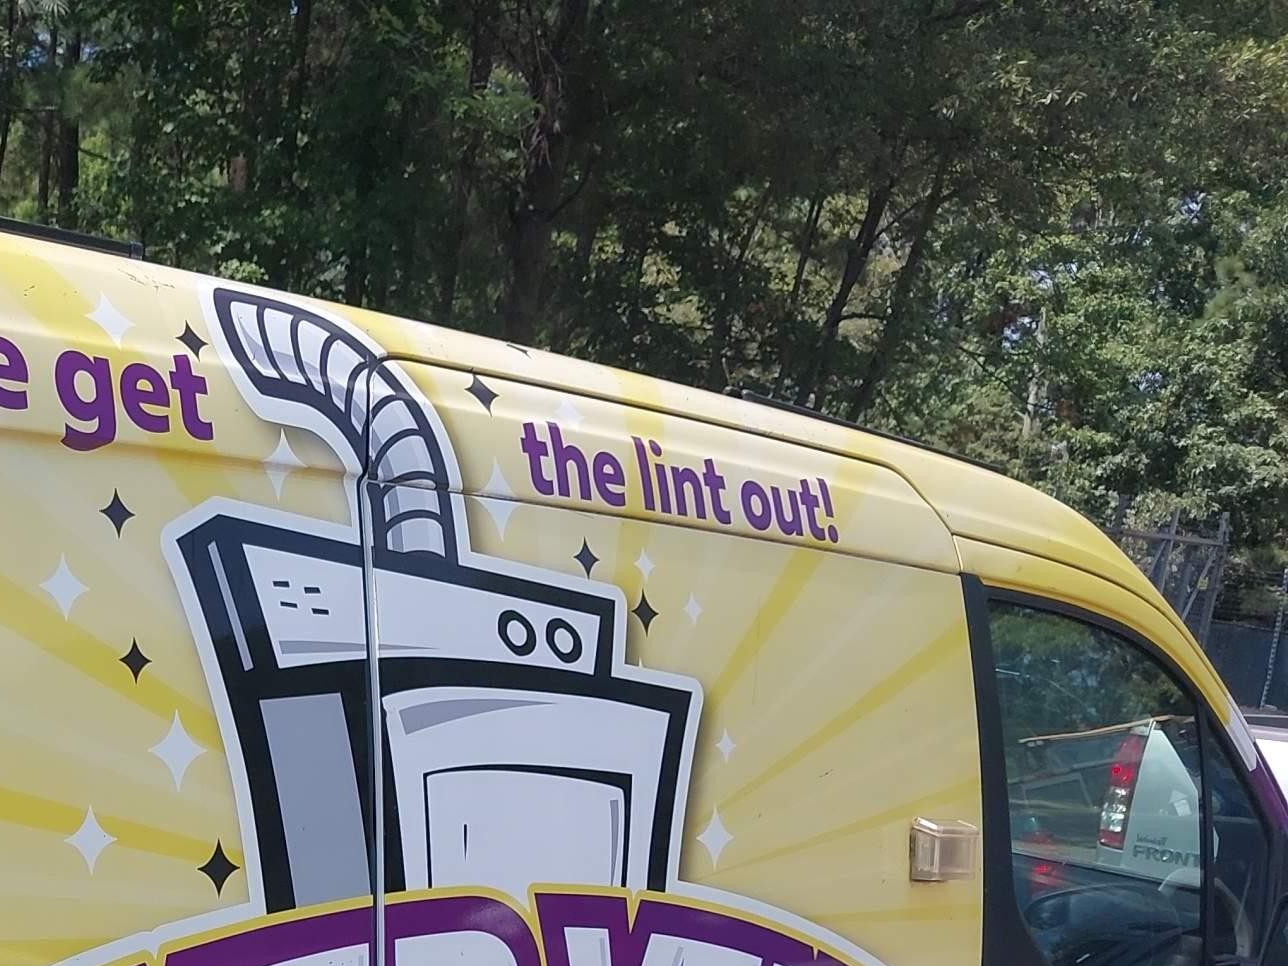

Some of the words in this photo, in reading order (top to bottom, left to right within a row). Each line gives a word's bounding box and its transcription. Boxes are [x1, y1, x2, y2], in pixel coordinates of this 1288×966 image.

[54, 349, 214, 452] get
[520, 421, 627, 507] the
[631, 435, 732, 526] lint
[740, 477, 840, 544] out!
